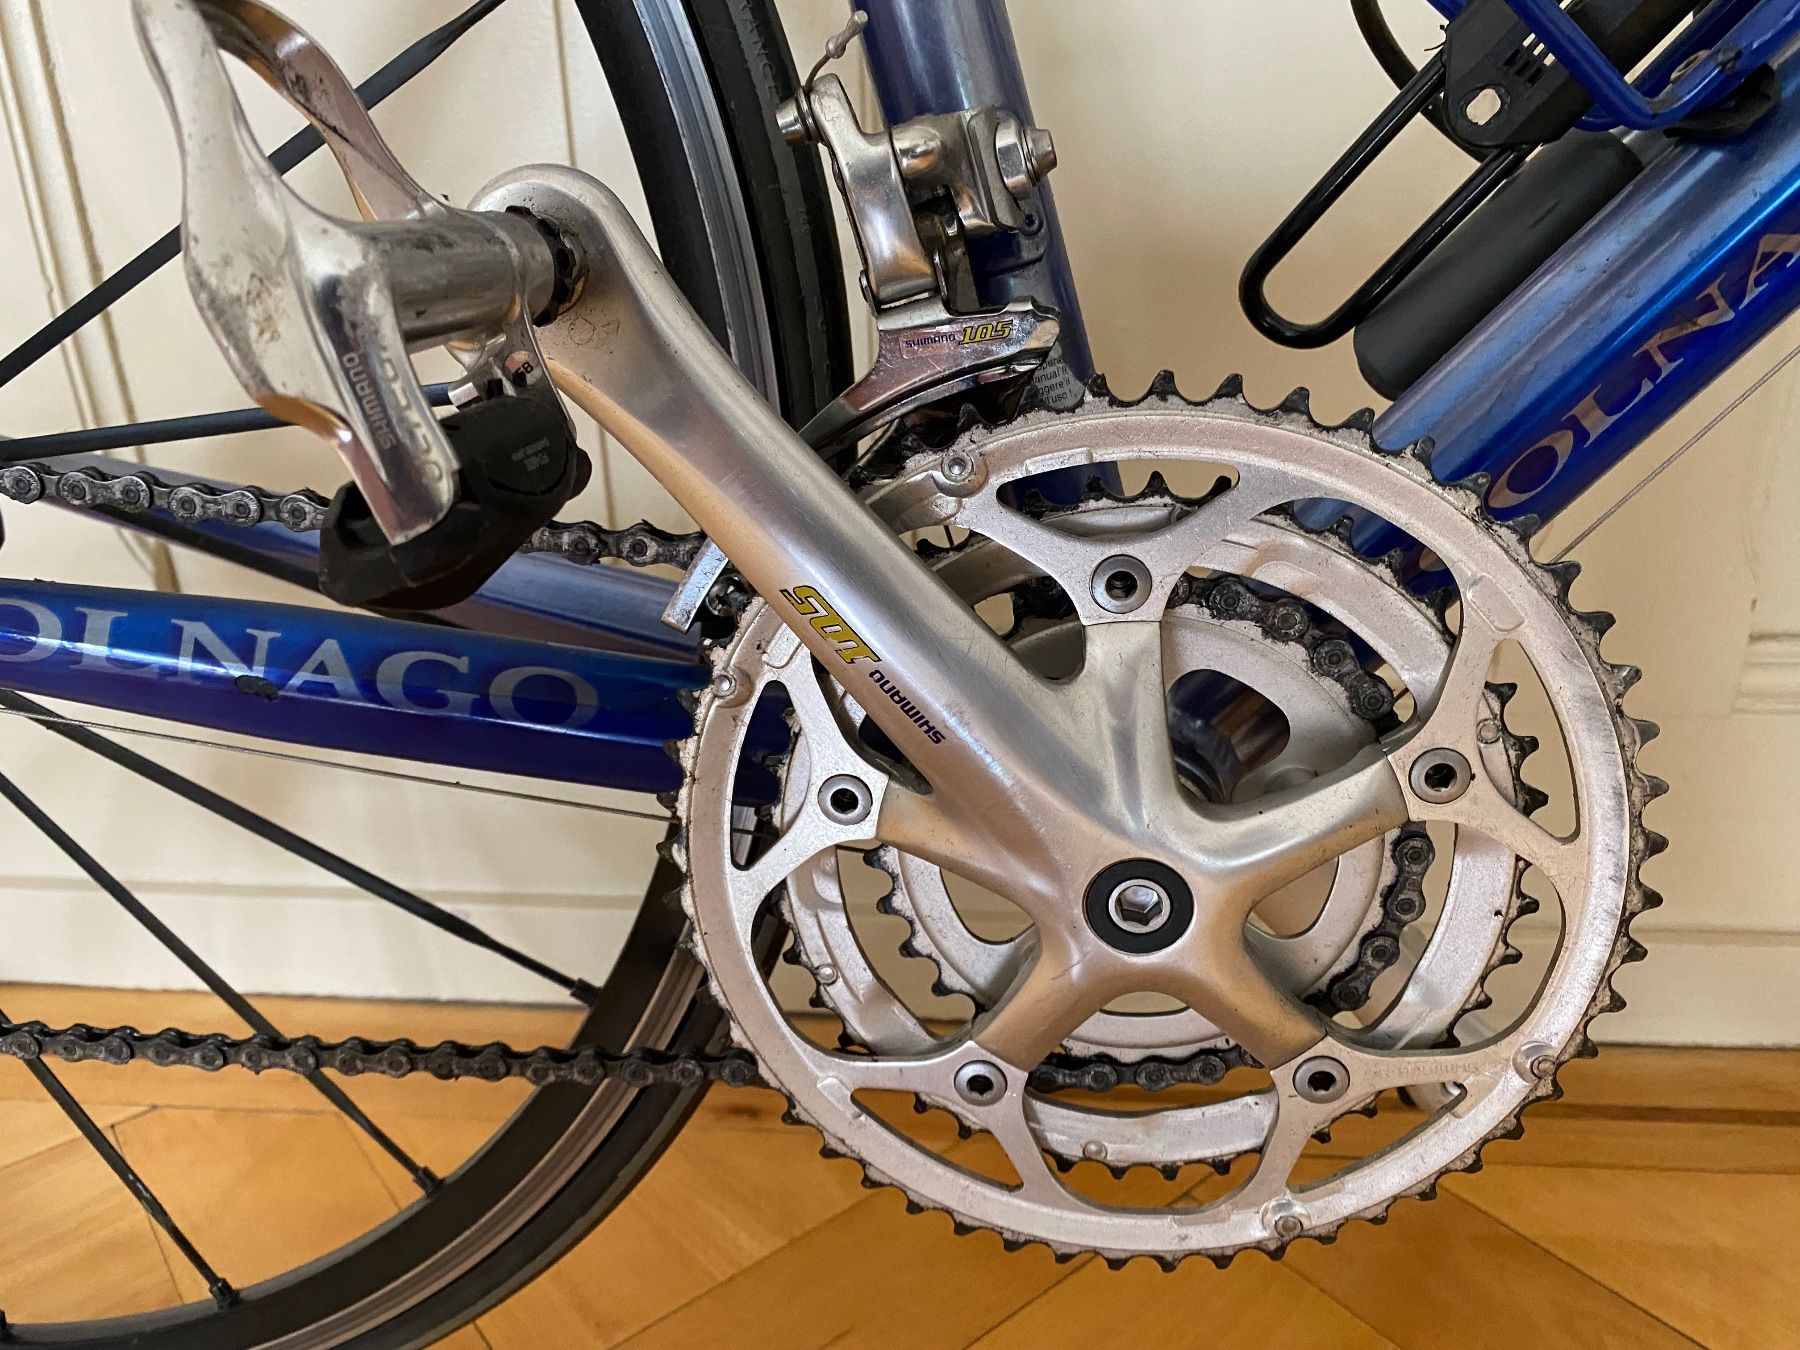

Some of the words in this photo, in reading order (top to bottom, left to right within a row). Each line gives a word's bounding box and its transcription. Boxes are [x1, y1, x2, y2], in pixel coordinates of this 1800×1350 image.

[905, 333, 956, 349] SHIMANO
[958, 319, 1014, 346] 105
[342, 351, 398, 451] SHIMANO
[1032, 366, 1060, 384] anual
[1418, 231, 1800, 573] OLNA
[779, 585, 882, 664] 105
[0, 597, 599, 732] OLNAGO
[868, 669, 946, 745] SHIMANO
